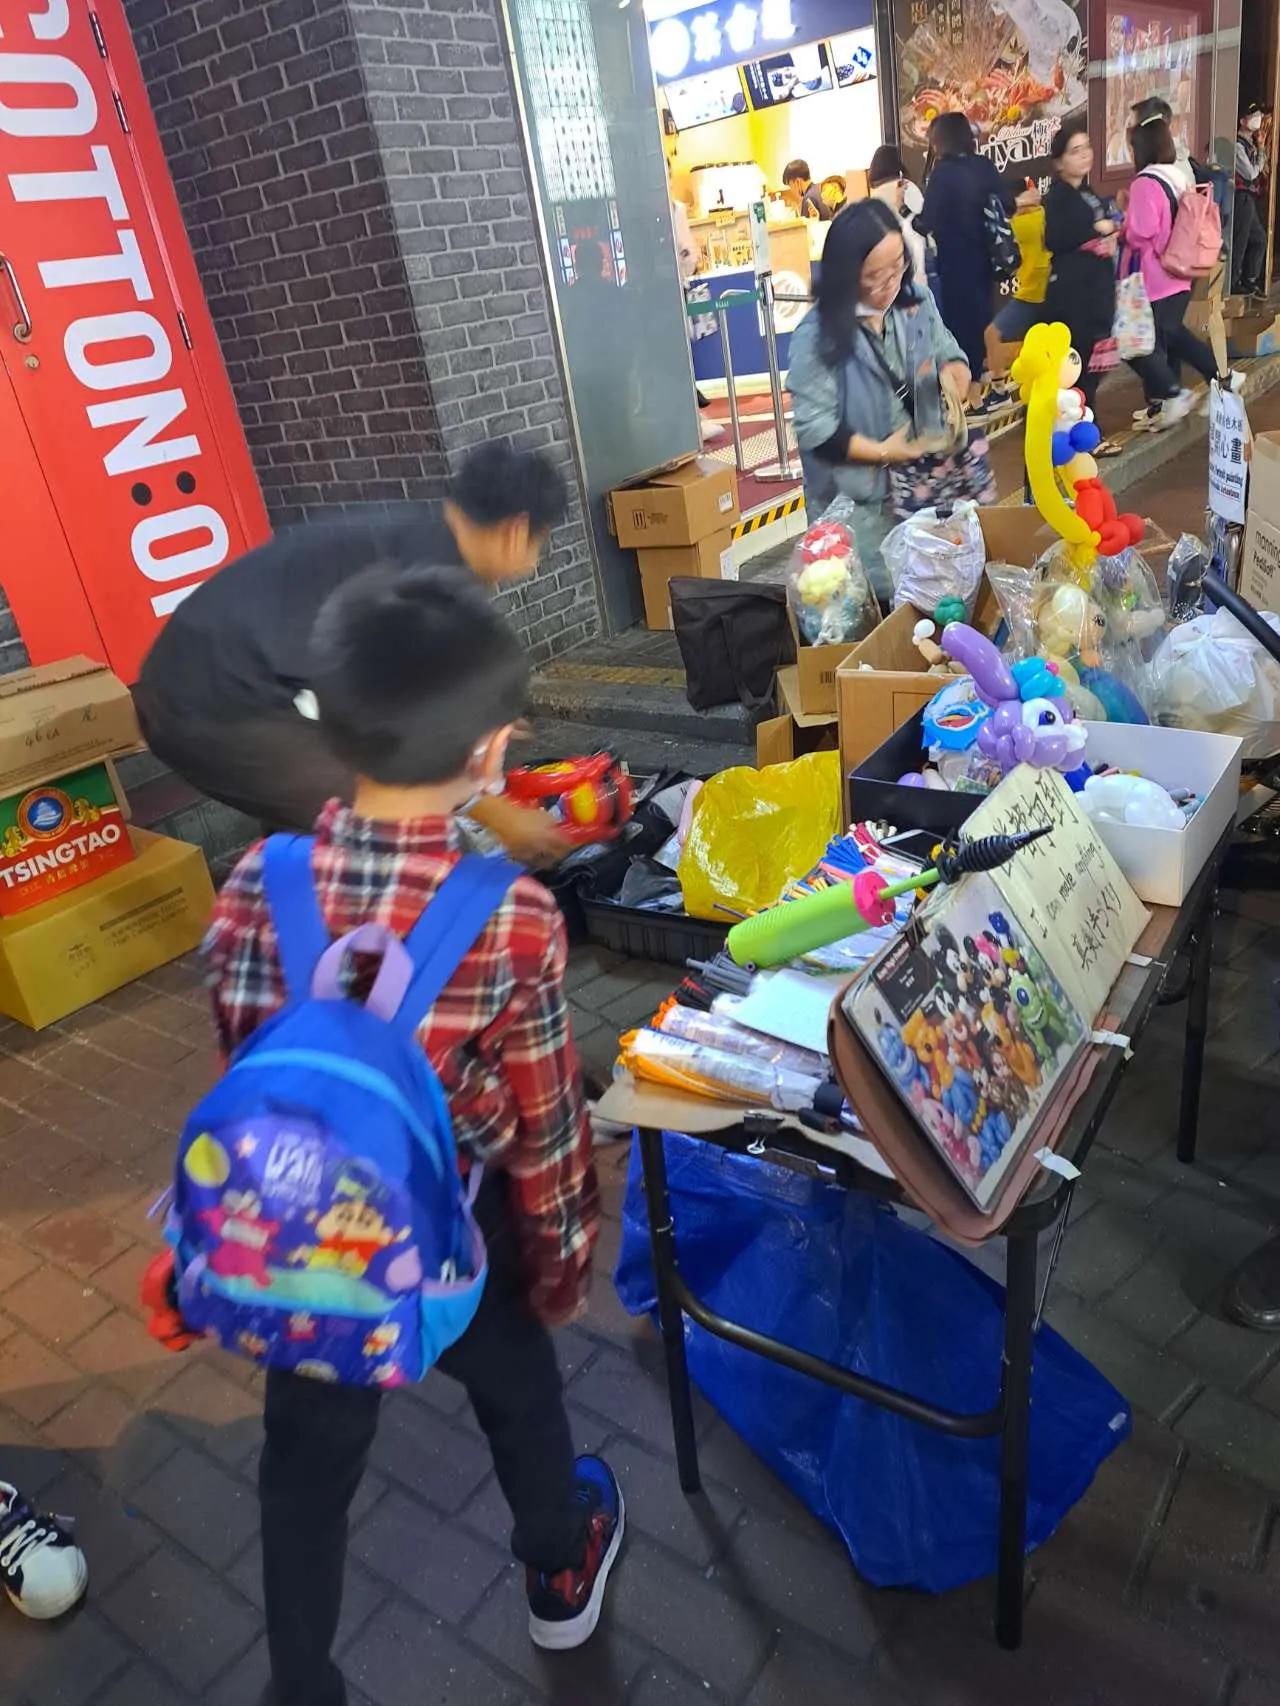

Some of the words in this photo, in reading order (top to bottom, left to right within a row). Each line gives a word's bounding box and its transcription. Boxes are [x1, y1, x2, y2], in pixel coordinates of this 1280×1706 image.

[0, 0, 230, 618] OTTON:O
[0, 823, 120, 888] TSINGTAO
[1030, 907, 1048, 939] I
[1058, 866, 1077, 902] make
